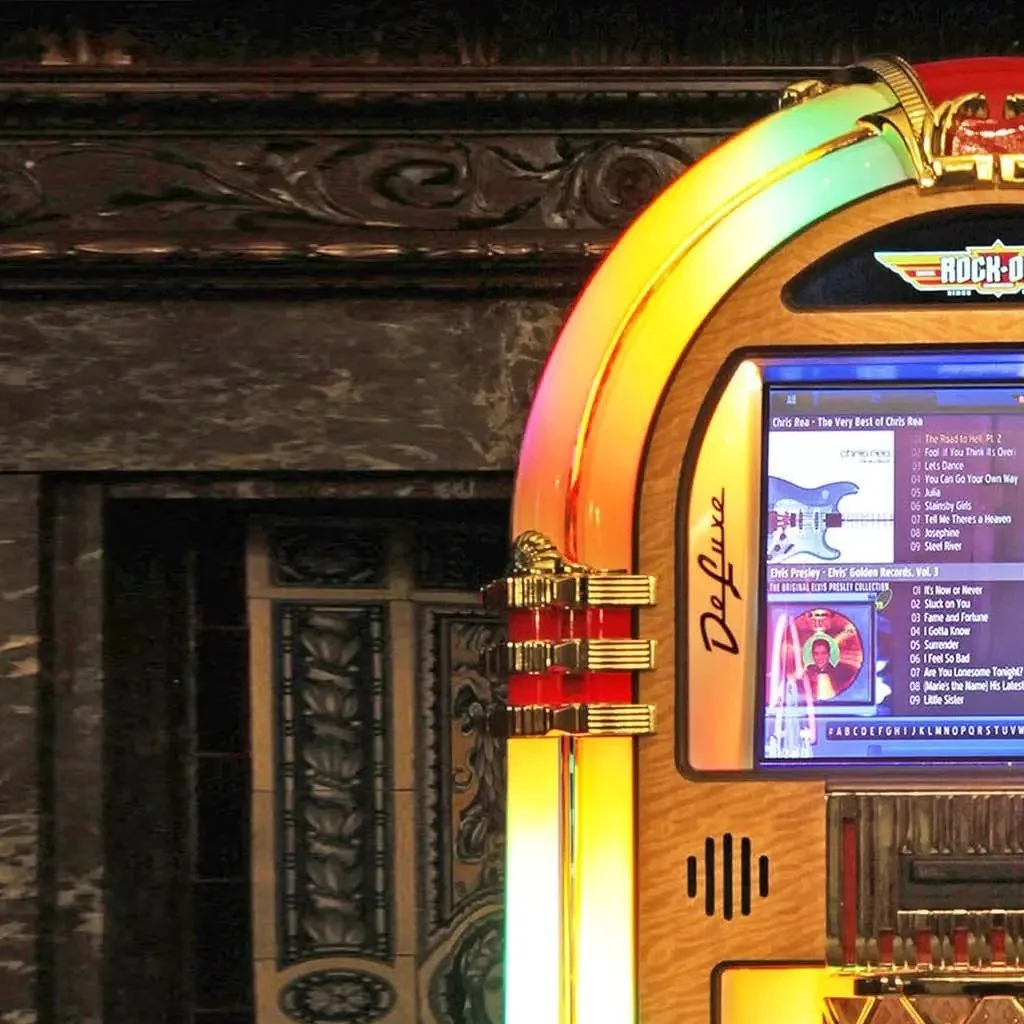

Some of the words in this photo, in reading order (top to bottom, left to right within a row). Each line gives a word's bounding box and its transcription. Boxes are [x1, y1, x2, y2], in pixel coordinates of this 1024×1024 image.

[772, 416, 792, 428] Chris
[794, 416, 810, 428] Rea
[818, 416, 832, 428] The
[835, 416, 853, 428] Very
[855, 416, 873, 428] Best
[875, 416, 884, 428] of
[885, 416, 905, 428] Chris
[907, 416, 923, 428] Rea
[925, 434, 939, 444] The
[940, 434, 958, 444] Road
[997, 434, 1002, 444] 2
[924, 447, 939, 457] Fool
[950, 447, 964, 457] You
[966, 447, 984, 457] Think
[942, 461, 965, 471] Dance
[925, 474, 938, 484] You
[940, 474, 954, 484] Can
[955, 474, 966, 484] Go
[967, 474, 984, 484] Your
[985, 474, 1002, 484] Own
[1003, 474, 1018, 485] Way
[911, 488, 921, 497] 05
[924, 488, 941, 497] Julia
[910, 501, 921, 511] 06
[924, 501, 954, 512] Stainsby
[956, 501, 972, 511] Girls
[911, 514, 921, 524] 07
[925, 514, 937, 524] Tell
[939, 514, 951, 524] Me
[984, 514, 1012, 524] Heaven
[911, 528, 921, 538] 08
[924, 528, 960, 539] Josephine
[910, 541, 921, 551] 09
[924, 541, 943, 551] Steel
[944, 541, 962, 551] River
[770, 568, 789, 578] Elvis
[791, 568, 820, 579] Presley
[850, 568, 878, 578] Golden
[934, 568, 939, 578] 3
[769, 583, 780, 592] THE
[781, 583, 810, 592] ORIGINAL
[811, 583, 827, 592] ELVIS
[829, 583, 853, 592] PRESLEY
[912, 586, 921, 595] 01
[935, 586, 951, 595] Now
[952, 586, 960, 595] or
[961, 586, 983, 595] Never
[910, 600, 921, 609] 02
[924, 600, 944, 609] Stuck
[945, 600, 955, 609] on
[956, 600, 971, 609] You
[911, 613, 921, 622] 03
[924, 613, 944, 622] Fame
[945, 613, 960, 622] and
[961, 613, 989, 622] Fortune
[910, 627, 921, 636] 04
[924, 627, 927, 636] I
[928, 627, 949, 636] Gotta
[950, 627, 971, 636] Know
[910, 640, 920, 650] 05
[924, 640, 959, 650] Surrender
[910, 654, 920, 663] 06
[924, 654, 927, 663] I
[928, 654, 943, 663] Feel
[945, 654, 954, 663] So
[956, 654, 970, 663] Bad
[910, 667, 920, 677] 07
[924, 667, 936, 677] Are
[938, 667, 952, 677] You
[954, 667, 991, 677] Lonesome
[992, 667, 1024, 679] Tonight?
[910, 681, 921, 691] 08
[951, 681, 963, 691] the
[990, 681, 1001, 691] His
[1002, 681, 1024, 691] Latest
[910, 695, 920, 705] 09
[924, 695, 943, 705] Little
[944, 695, 964, 705] Sister
